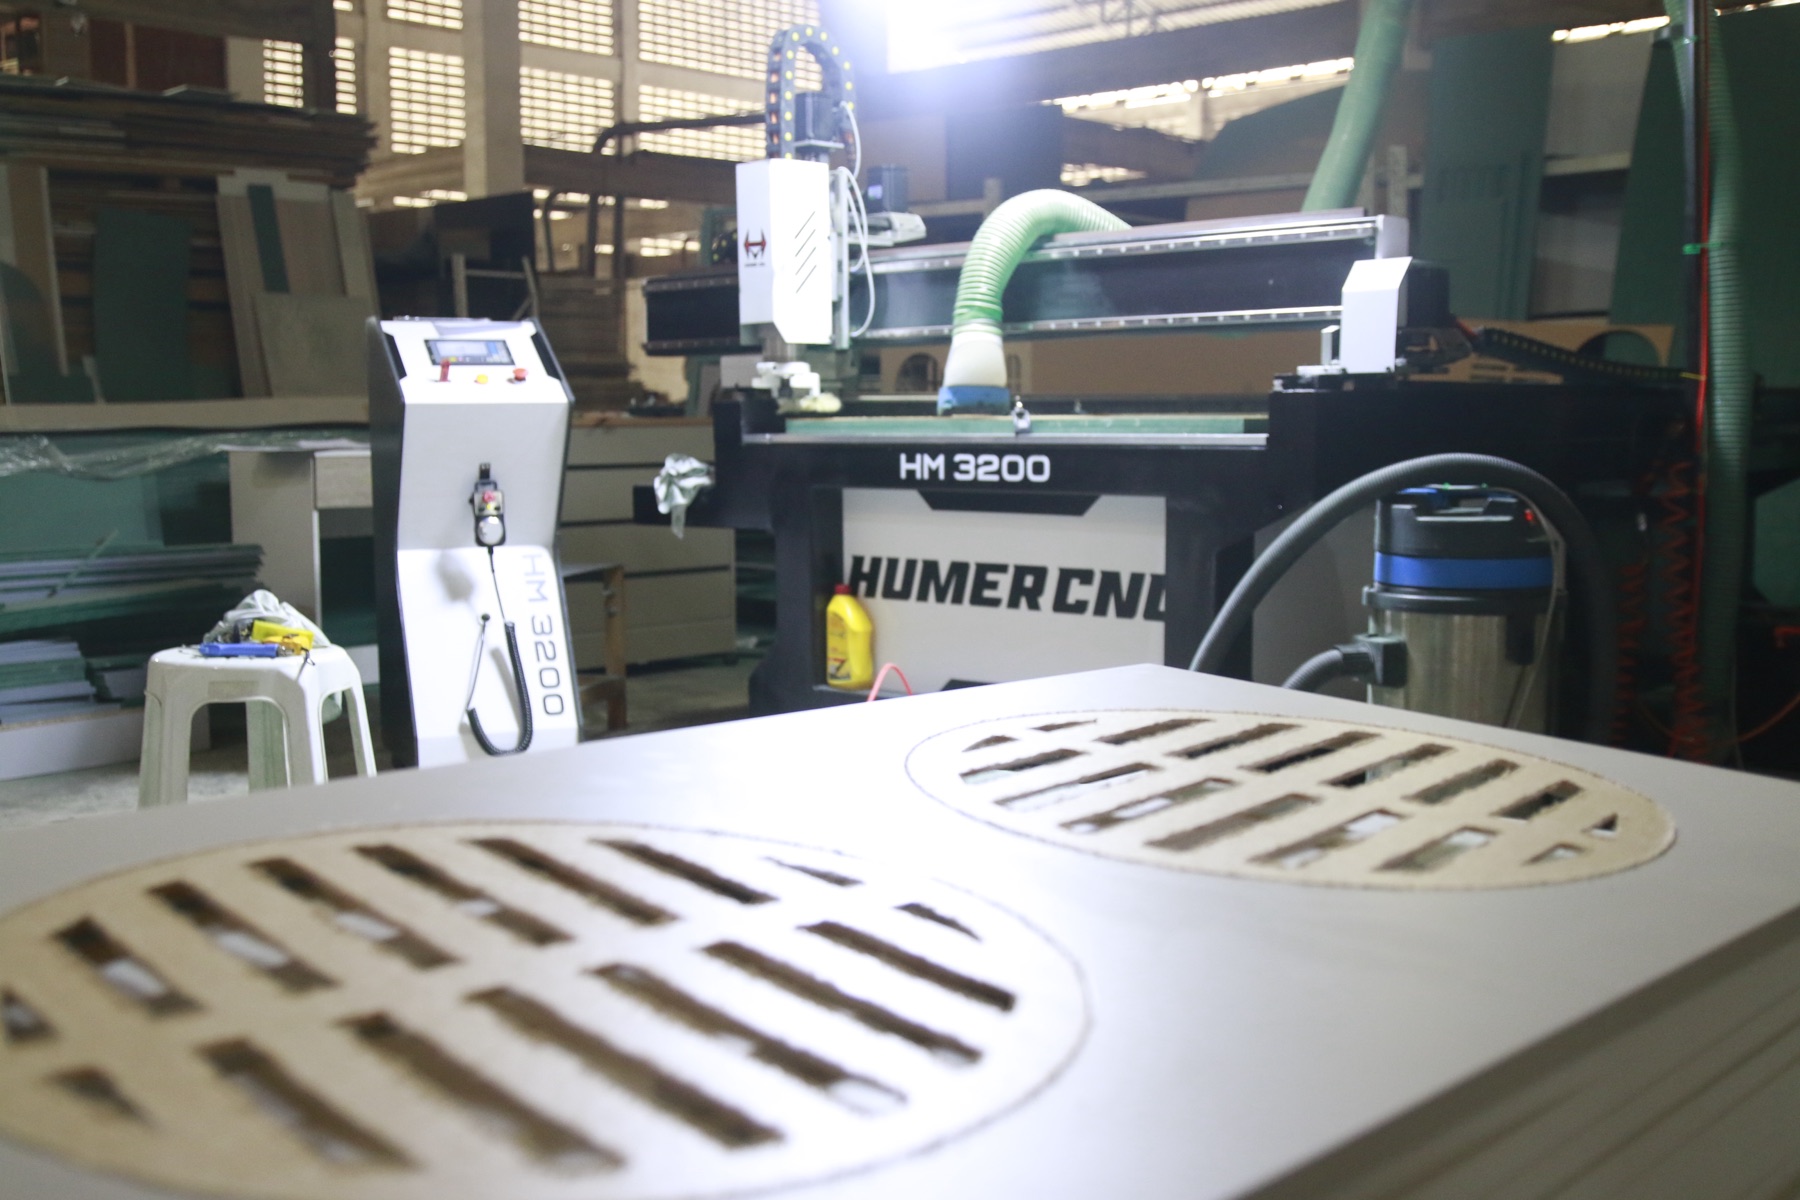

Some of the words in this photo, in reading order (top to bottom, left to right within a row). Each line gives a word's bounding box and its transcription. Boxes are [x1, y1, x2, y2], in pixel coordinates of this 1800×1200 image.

[900, 453, 945, 480] HM
[953, 453, 1051, 482] 3200
[522, 554, 549, 602] HM
[531, 614, 565, 716] 3200
